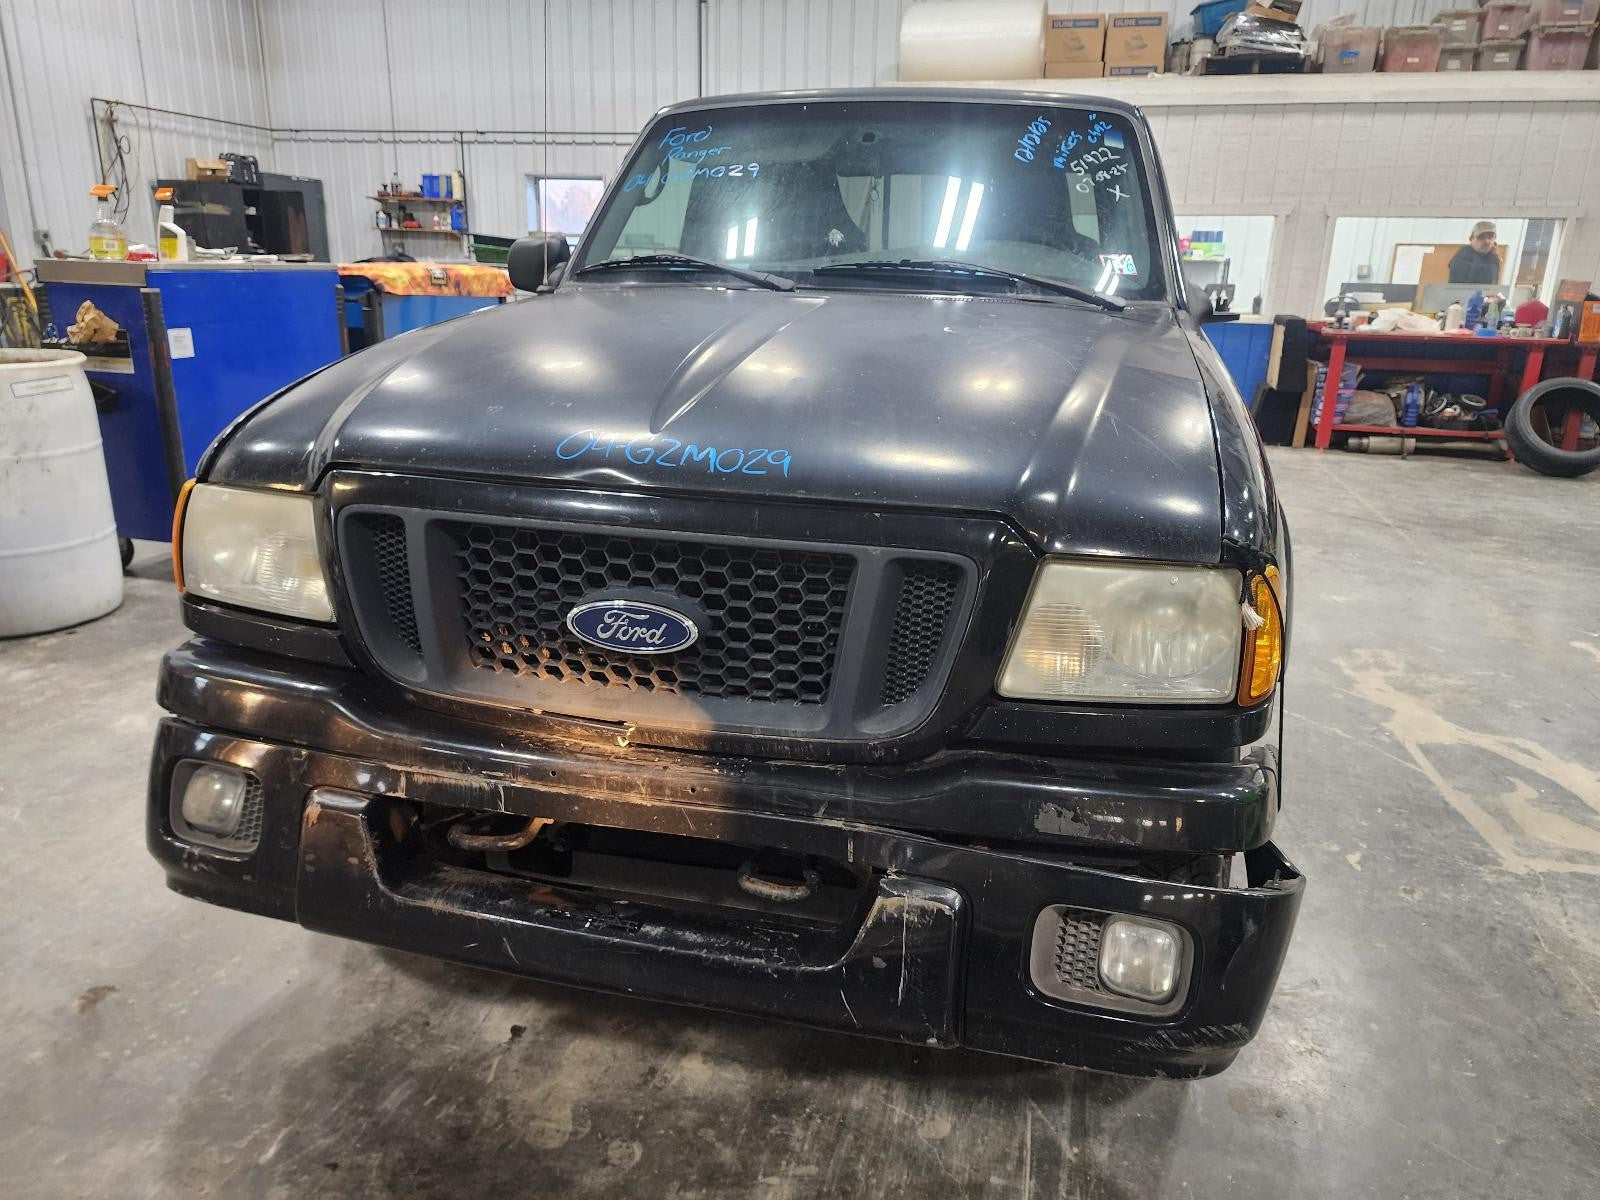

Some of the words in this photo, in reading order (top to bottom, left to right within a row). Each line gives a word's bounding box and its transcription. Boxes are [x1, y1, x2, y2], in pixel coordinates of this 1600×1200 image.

[658, 125, 713, 150] Ford
[661, 146, 732, 166] Ranger
[1069, 147, 1121, 176] 51922
[596, 609, 667, 646] Ford
